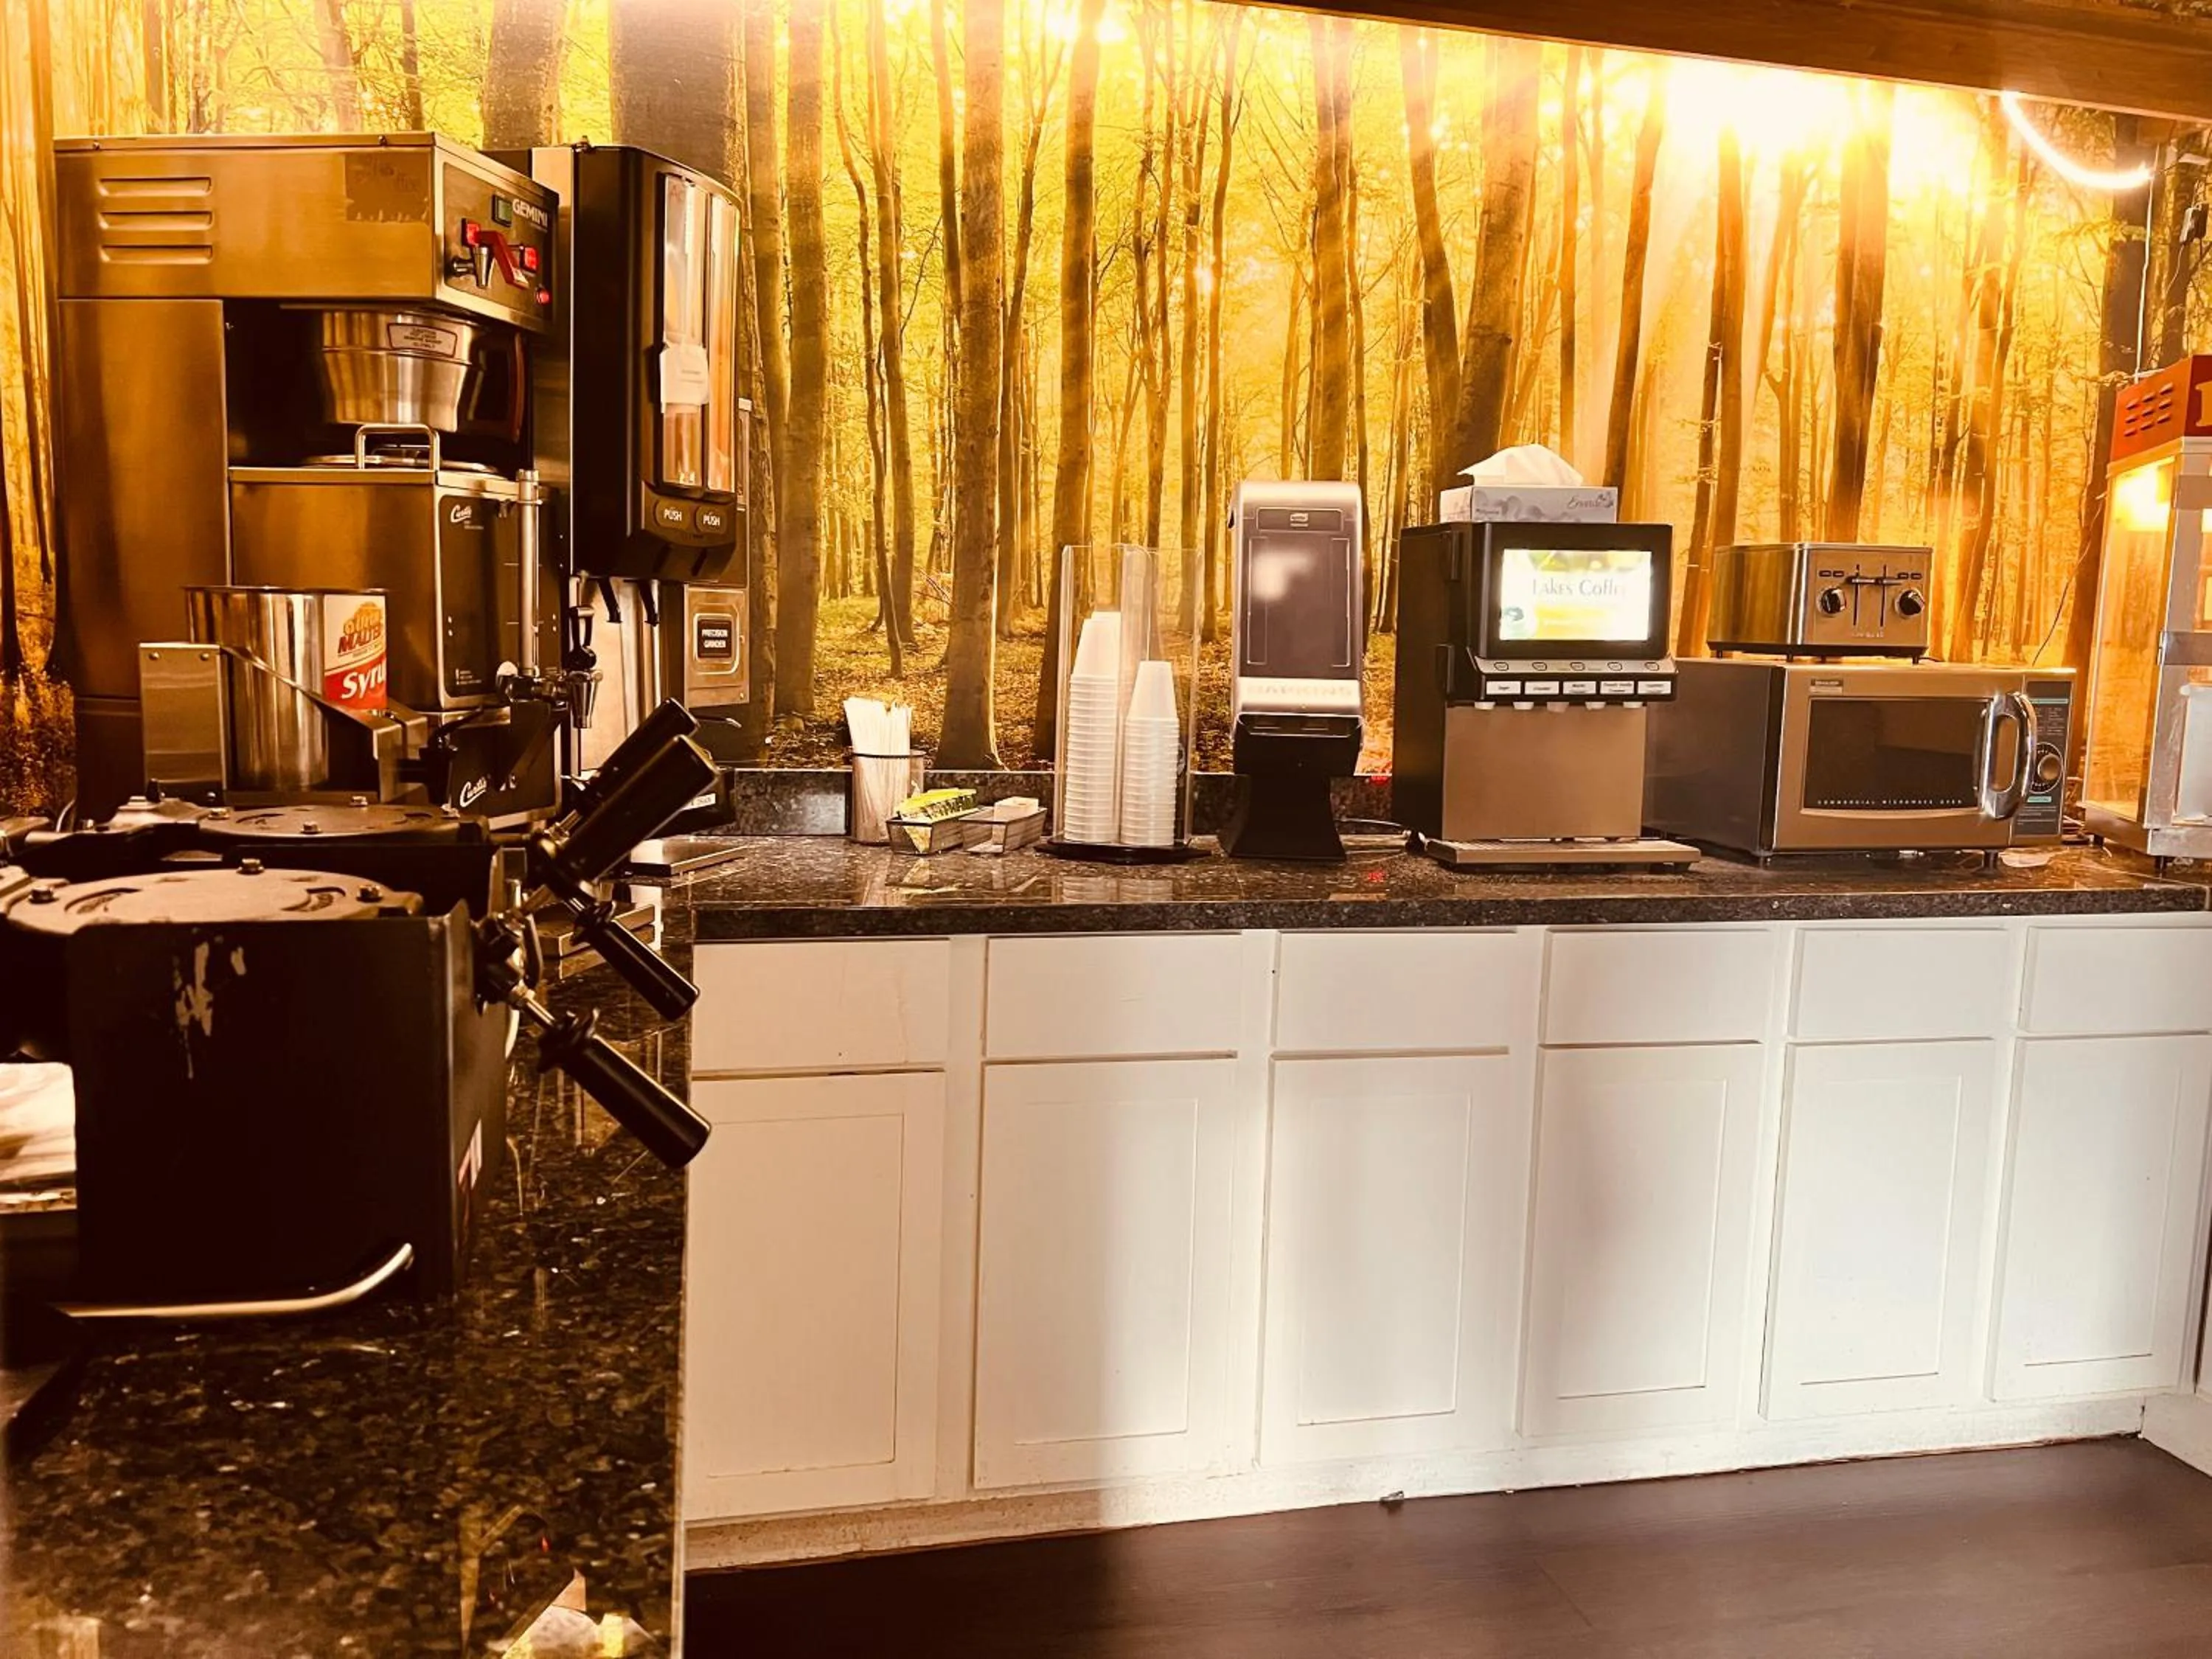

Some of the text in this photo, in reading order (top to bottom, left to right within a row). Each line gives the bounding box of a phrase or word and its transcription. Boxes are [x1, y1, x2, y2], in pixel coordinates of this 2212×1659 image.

[512, 198, 548, 227] GEMINI
[451, 504, 473, 523] Curtis
[664, 508, 682, 521] PUSH
[703, 514, 720, 526] PUSH
[459, 776, 487, 807] Curtis
